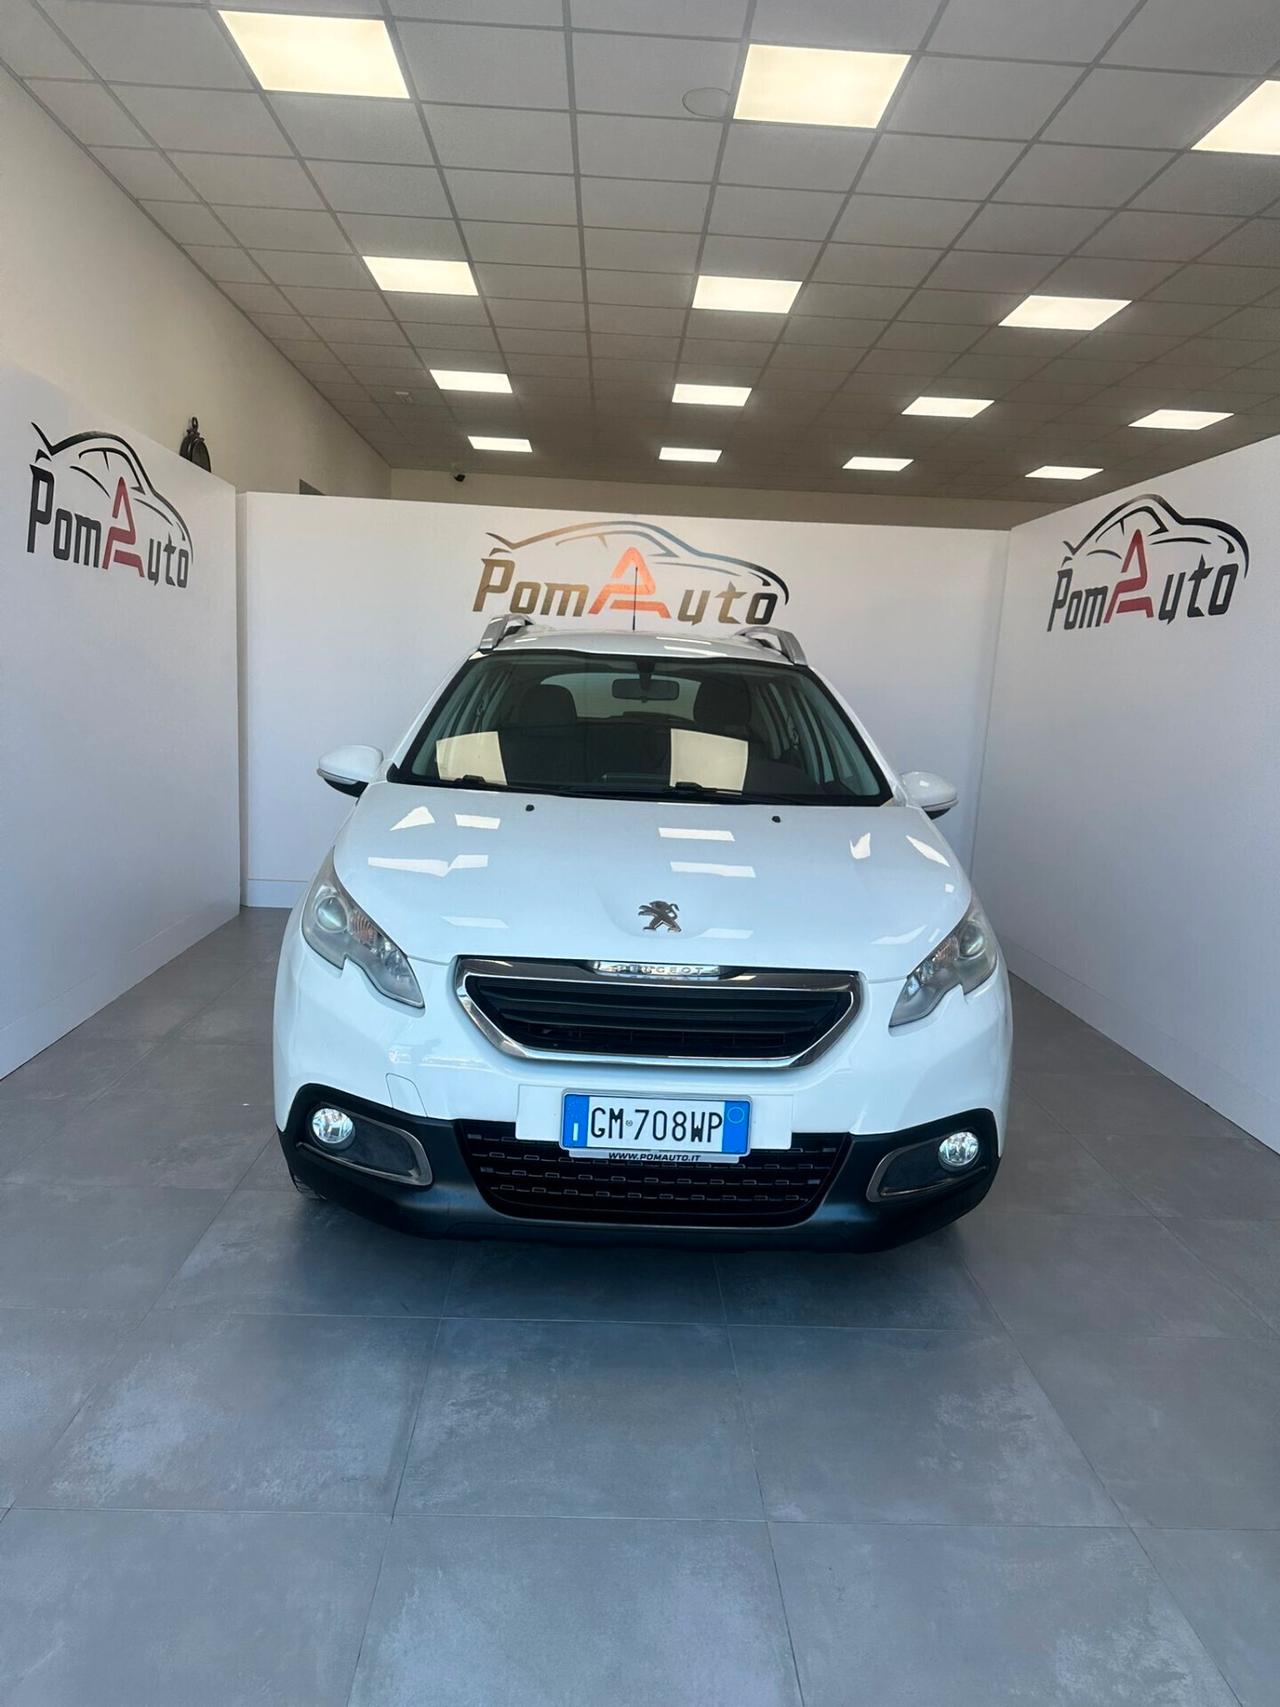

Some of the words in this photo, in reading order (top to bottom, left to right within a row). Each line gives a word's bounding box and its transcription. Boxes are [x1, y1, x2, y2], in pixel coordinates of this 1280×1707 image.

[26, 463, 190, 588] PomAuto
[472, 546, 779, 626] PomAuto
[1046, 528, 1239, 633] PomAuto
[607, 1151, 702, 1162] WWW.POMAUTO.IT
